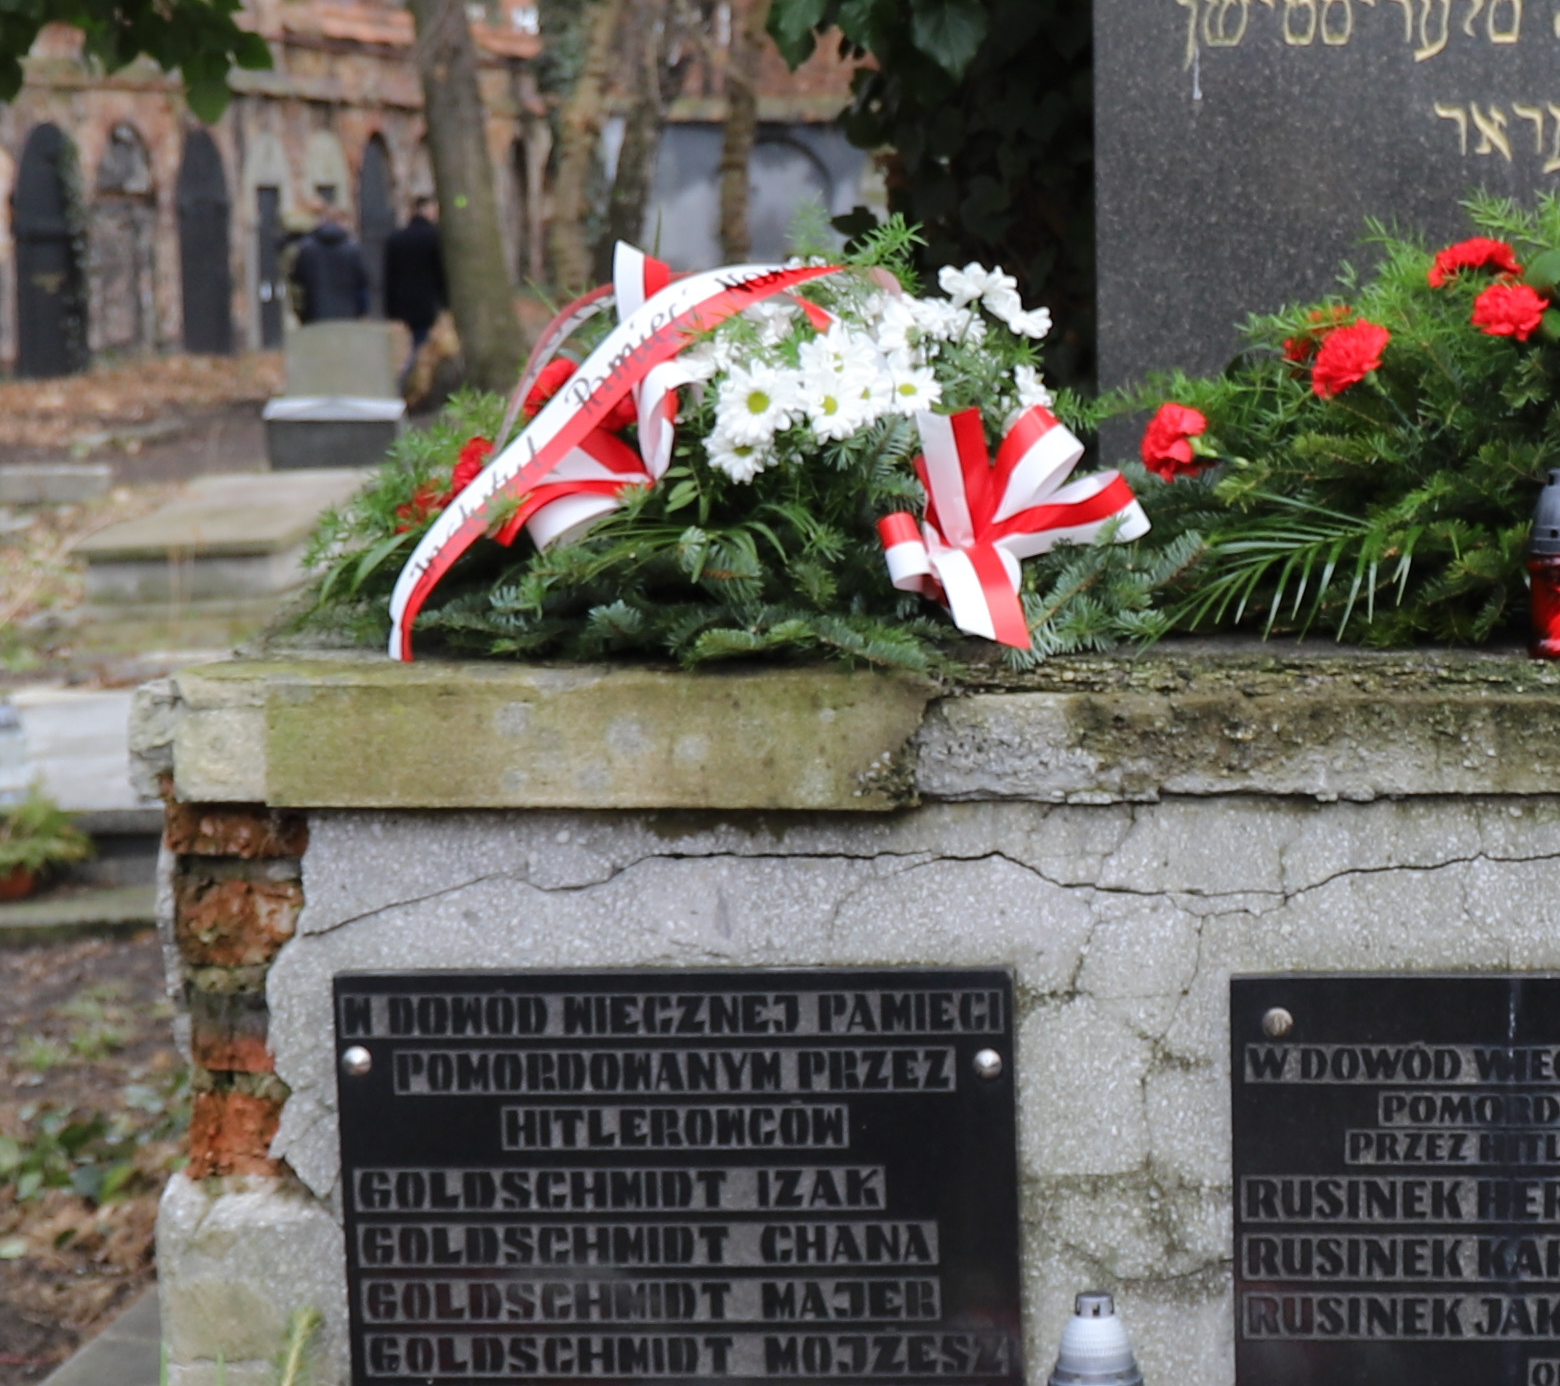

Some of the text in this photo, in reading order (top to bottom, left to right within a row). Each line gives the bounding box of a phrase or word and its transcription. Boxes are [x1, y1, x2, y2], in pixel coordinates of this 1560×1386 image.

[341, 994, 373, 1036] W
[562, 993, 800, 1036] WIECZNEJ
[396, 1049, 950, 1093] POMORDOWANYM PRZEZ
[1247, 1048, 1289, 1081] W
[1300, 1043, 1462, 1081] DOWÓD
[1348, 1132, 1469, 1164] PRZEZ
[357, 1168, 884, 1210] GOLDSCHMIDT IZAK
[1245, 1180, 1464, 1222] RUSINEK
[361, 1224, 933, 1265] GOLDSCHMIDT CHANA
[1245, 1237, 1465, 1279] RUSINEK
[365, 1280, 937, 1321] GOLDSCHMIDT MAJER
[1246, 1295, 1465, 1338] RUSINEK
[368, 1336, 735, 1376] GOLDSCHMIDT
